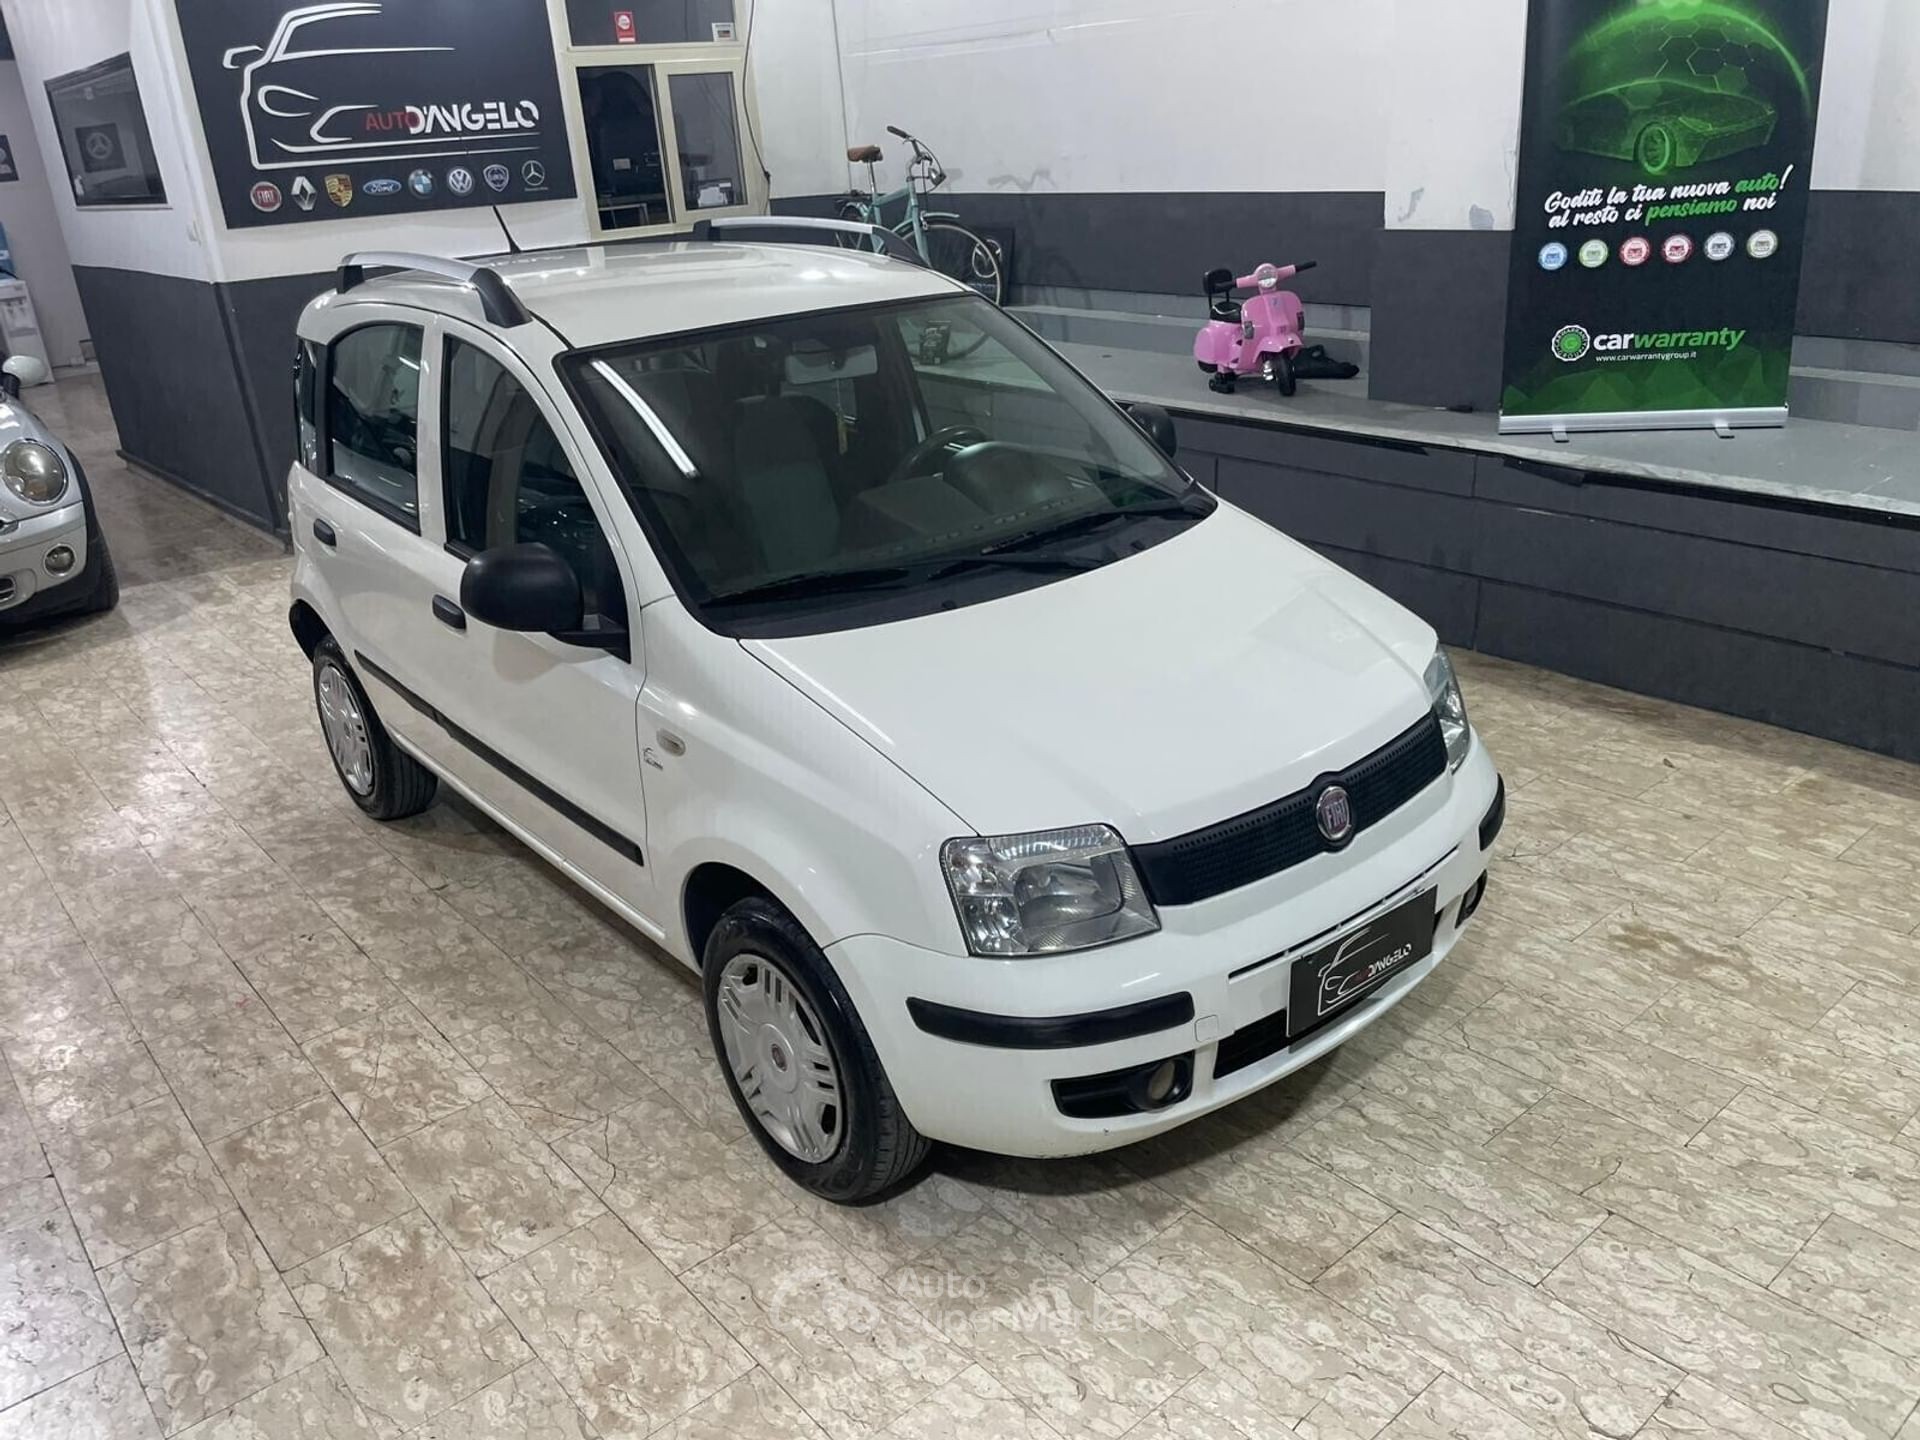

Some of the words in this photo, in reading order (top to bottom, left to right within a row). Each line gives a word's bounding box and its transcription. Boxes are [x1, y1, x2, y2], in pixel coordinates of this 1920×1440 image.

[366, 111, 421, 131] AUTO
[1544, 188, 1603, 213] Goditi
[1606, 186, 1628, 204] la
[1632, 184, 1667, 202] tua
[1670, 181, 1731, 199] nuova
[1548, 209, 1571, 228] al
[1573, 205, 1619, 226] resto
[1624, 203, 1643, 221] ci
[1644, 199, 1738, 227] pensiamo
[1742, 191, 1777, 211] noi
[1595, 351, 1697, 362] www.carwarrantygroup.it
